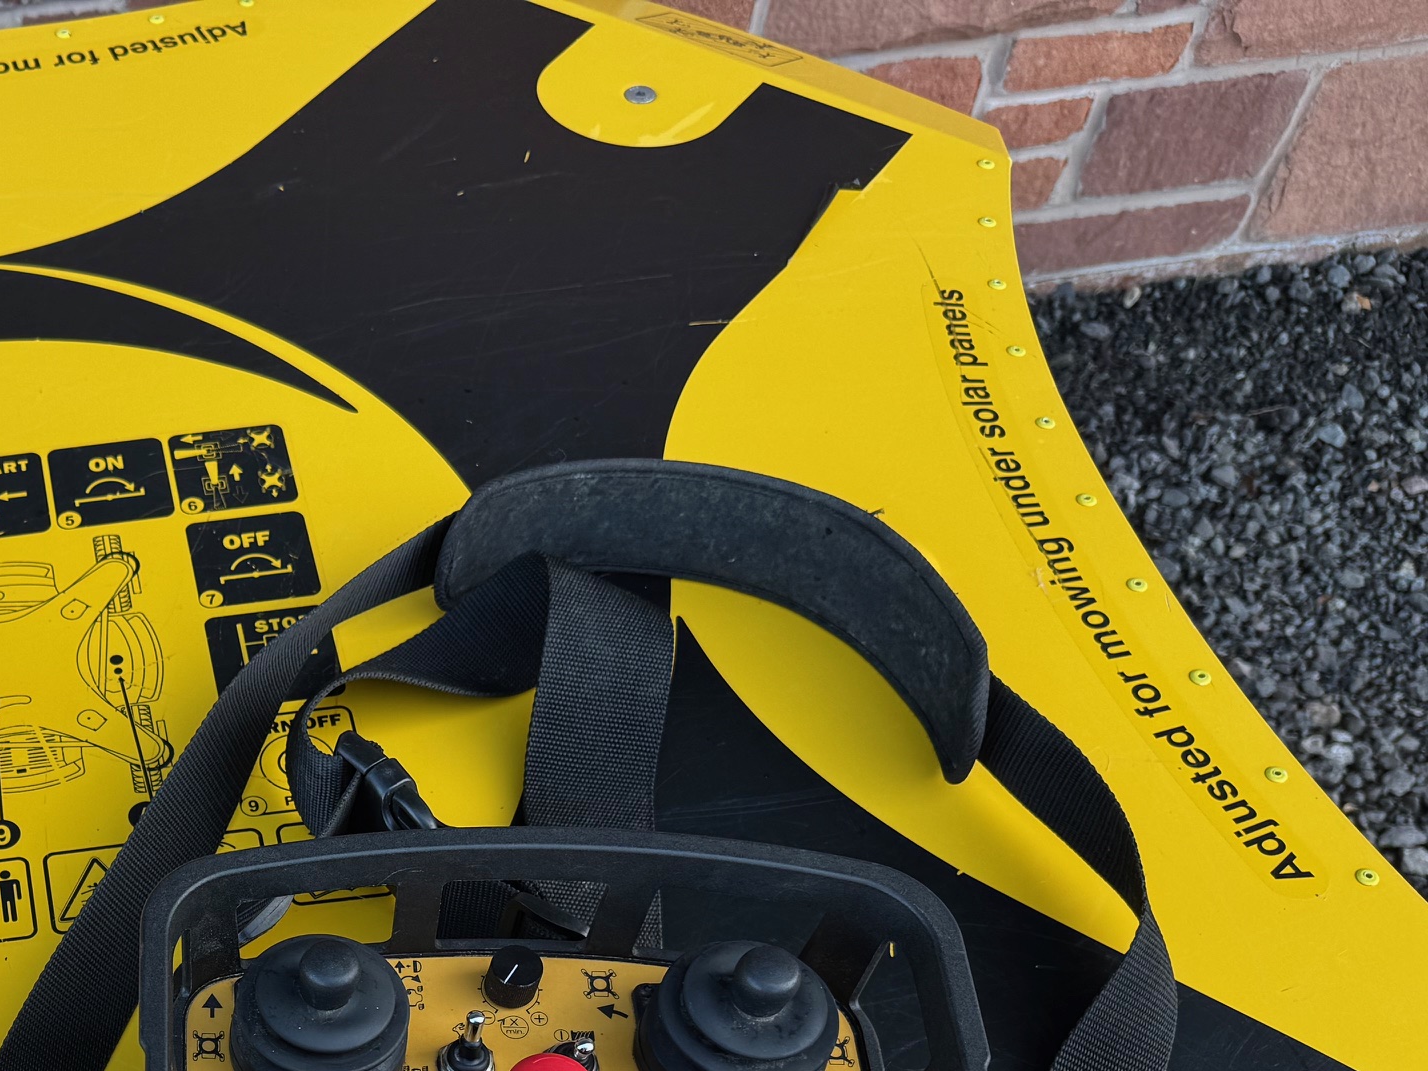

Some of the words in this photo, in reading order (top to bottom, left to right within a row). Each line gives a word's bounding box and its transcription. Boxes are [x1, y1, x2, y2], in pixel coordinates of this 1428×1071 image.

[108, 20, 248, 62] Adjusted
[53, 49, 100, 68] for
[933, 288, 989, 367] panels
[960, 374, 1007, 440] solar
[88, 454, 125, 473] ON
[987, 446, 1051, 529] under
[188, 501, 197, 512] 6
[65, 515, 74, 526] 5
[222, 530, 270, 550] OFF
[206, 594, 216, 605] 7
[1037, 536, 1132, 660] mowing
[254, 614, 305, 633] STO
[1117, 671, 1172, 718] for
[269, 719, 292, 733] RN
[248, 800, 259, 812] 9
[1153, 725, 1315, 880] Adjusted
